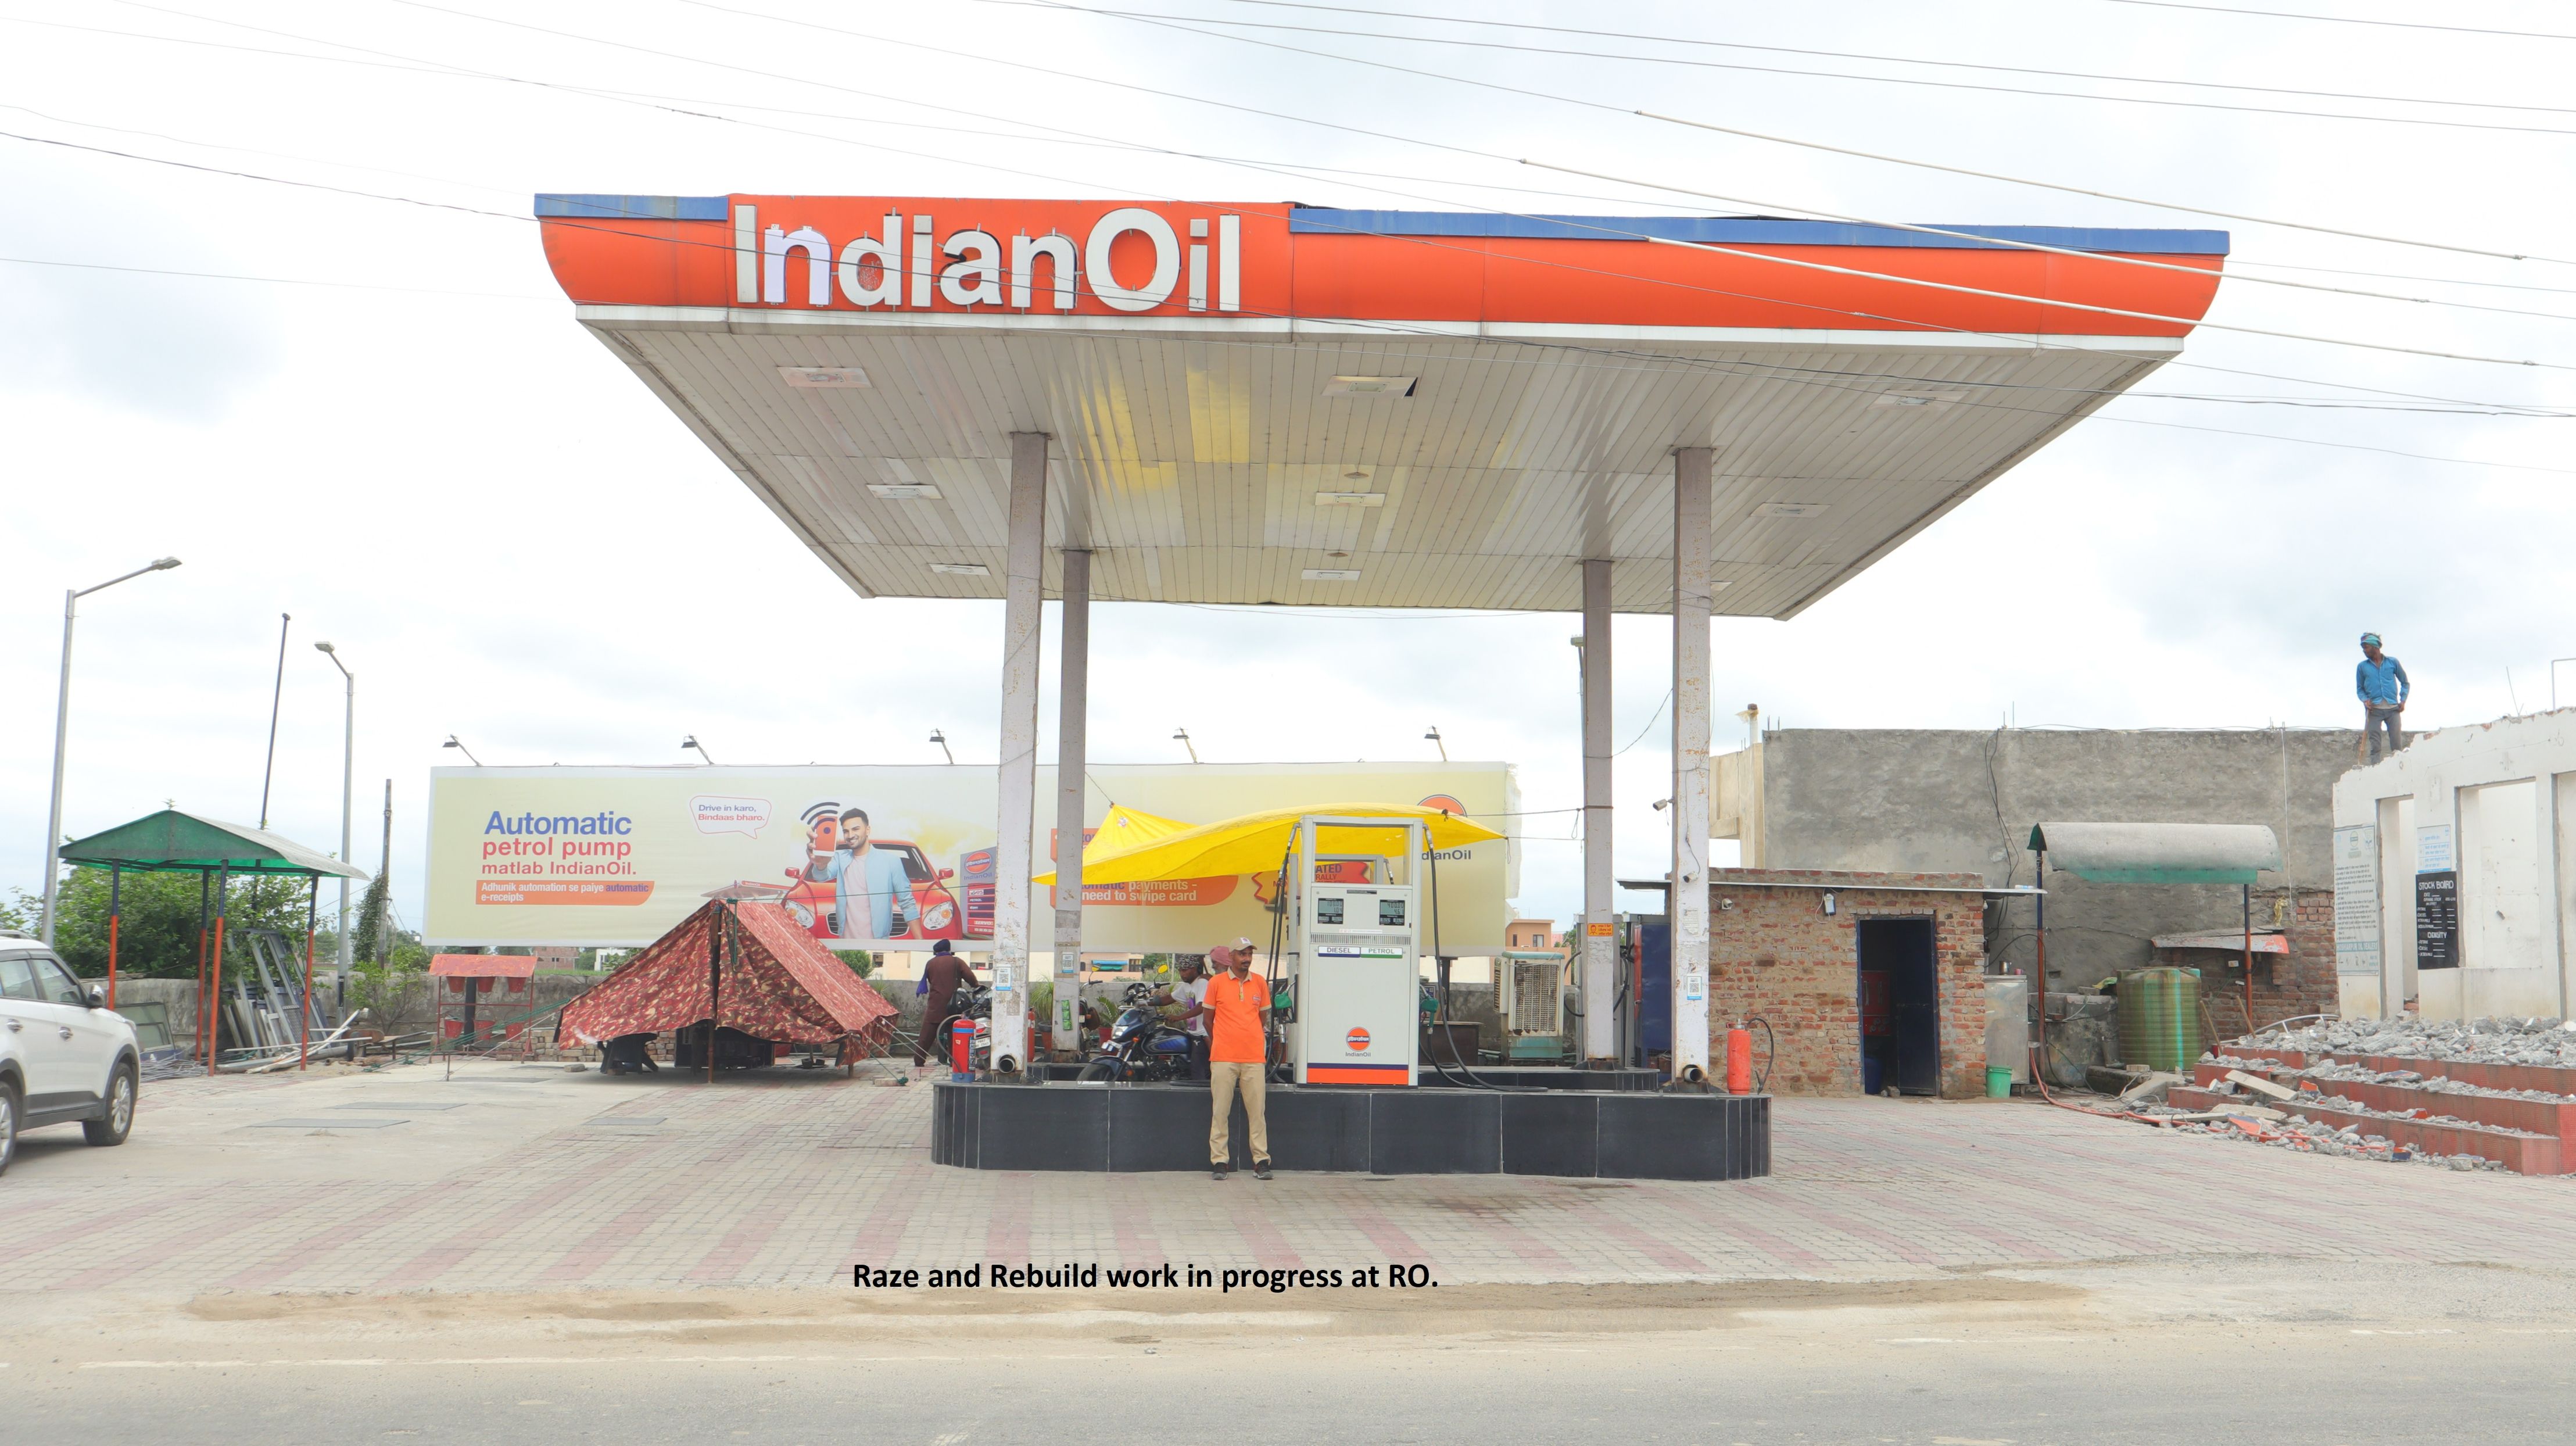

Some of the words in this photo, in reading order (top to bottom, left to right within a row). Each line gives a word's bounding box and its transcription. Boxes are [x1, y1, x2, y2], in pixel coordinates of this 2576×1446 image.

[735, 205, 1239, 312] IndianOil
[484, 811, 632, 835] Automatic
[483, 837, 553, 860] petrol
[563, 841, 631, 860] pump
[1421, 850, 1471, 860] danOil
[482, 861, 543, 875] matlab
[550, 861, 637, 875] IndianOil.
[963, 872, 993, 881] IndianOil
[481, 882, 517, 892] Adhunik
[518, 882, 567, 892] automation
[568, 884, 579, 892] se
[581, 883, 604, 894] paiye
[606, 883, 649, 892] automatic
[1128, 879, 1188, 892] payments
[2419, 881, 2435, 890] STOCK
[2436, 880, 2454, 889] BOARD
[481, 893, 524, 903] e-receipts
[1081, 890, 1111, 900] need
[1115, 890, 1126, 901] to
[1130, 890, 1166, 904] swipe
[1169, 890, 1196, 901] card
